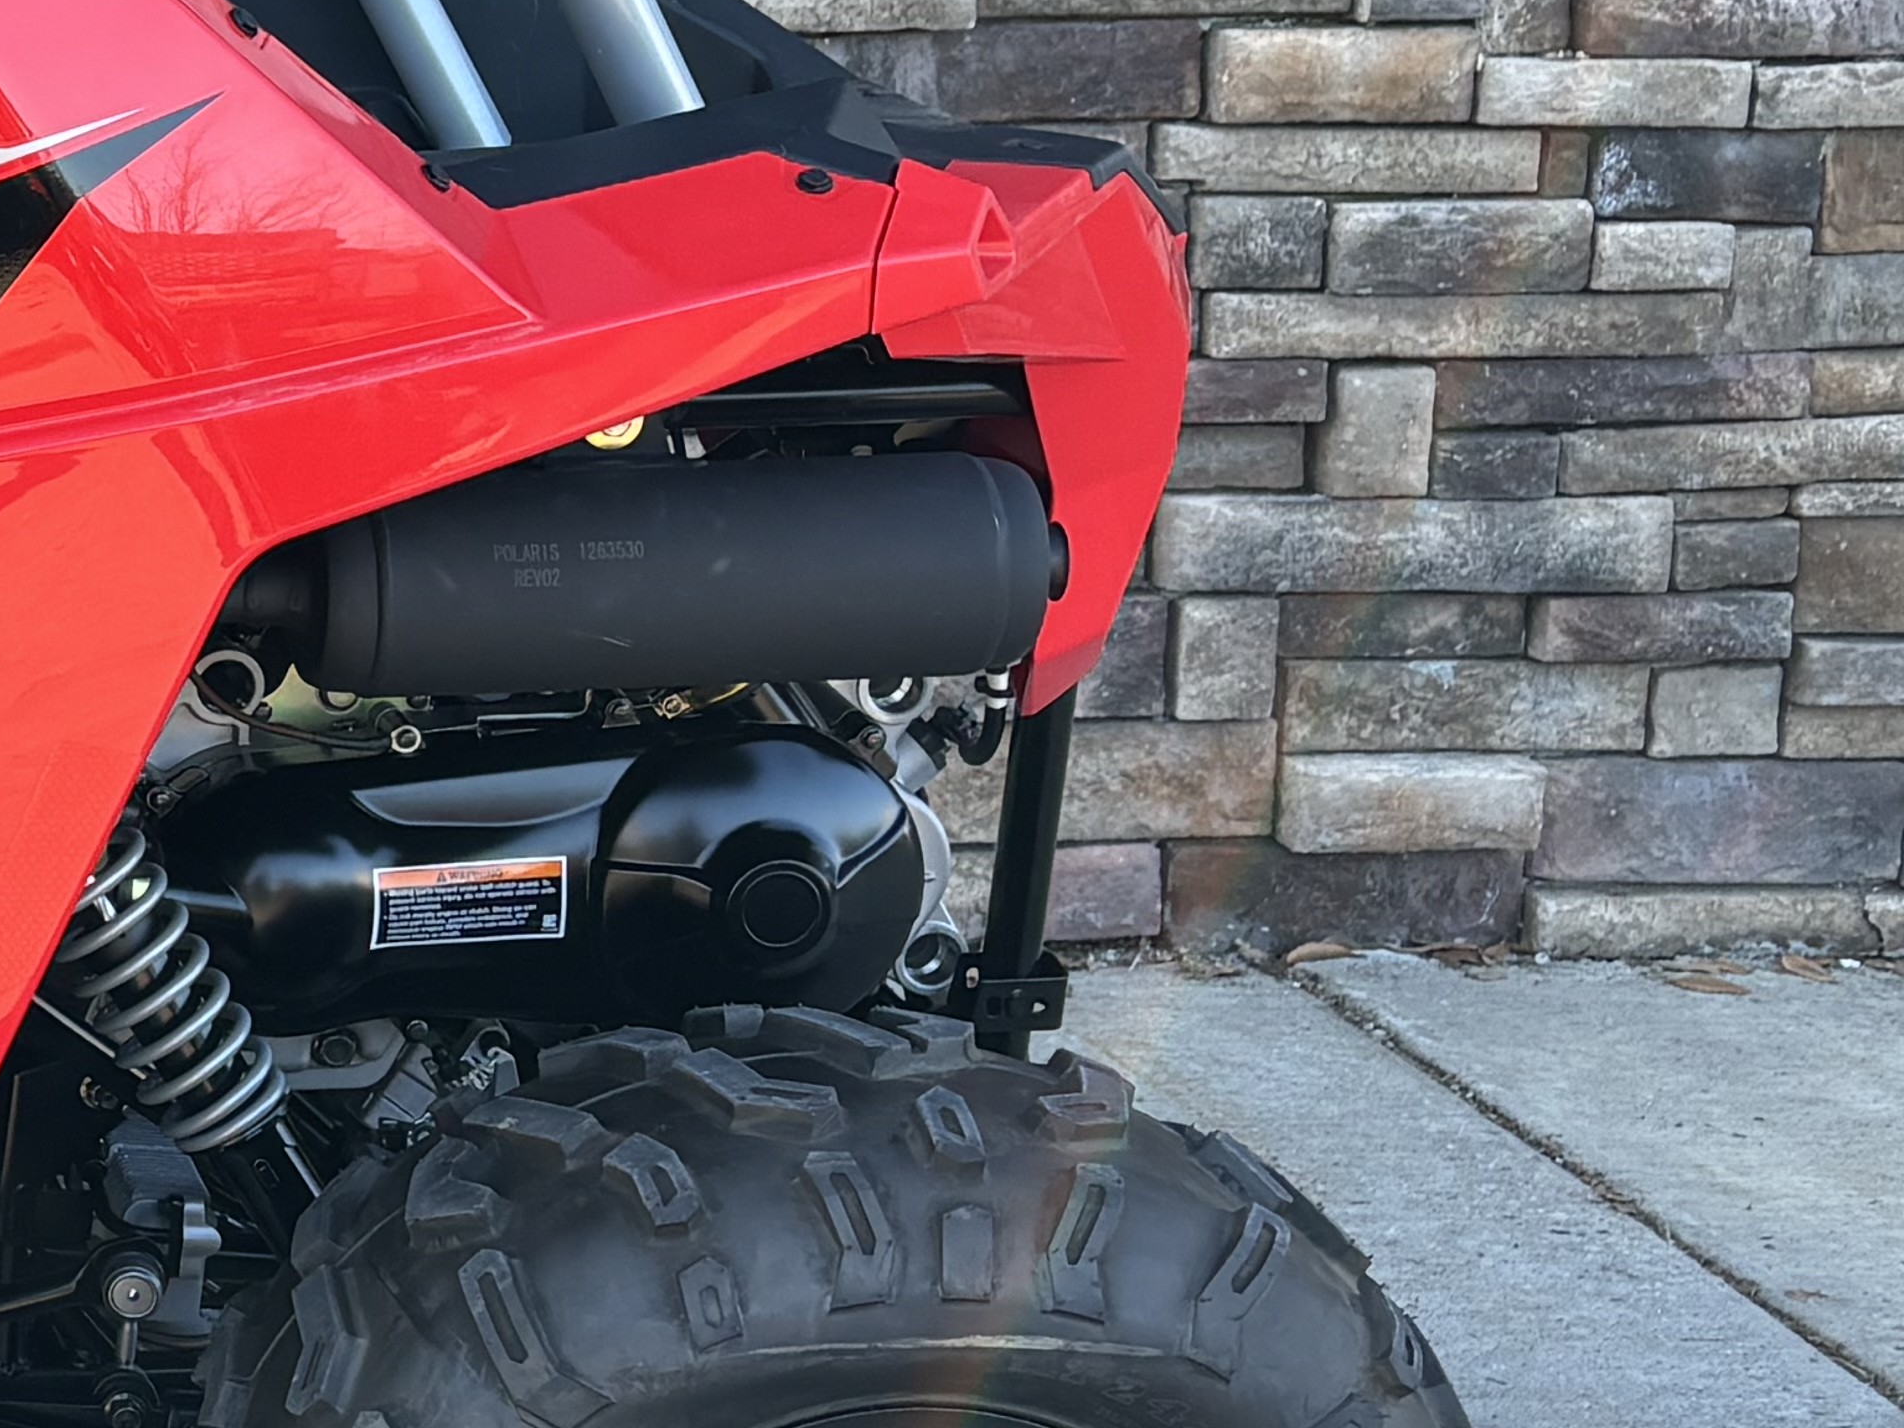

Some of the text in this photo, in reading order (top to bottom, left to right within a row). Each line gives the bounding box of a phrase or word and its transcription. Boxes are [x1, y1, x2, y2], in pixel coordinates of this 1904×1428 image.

[493, 541, 645, 562] POLARIS 1263530
[514, 568, 561, 587] REV02
